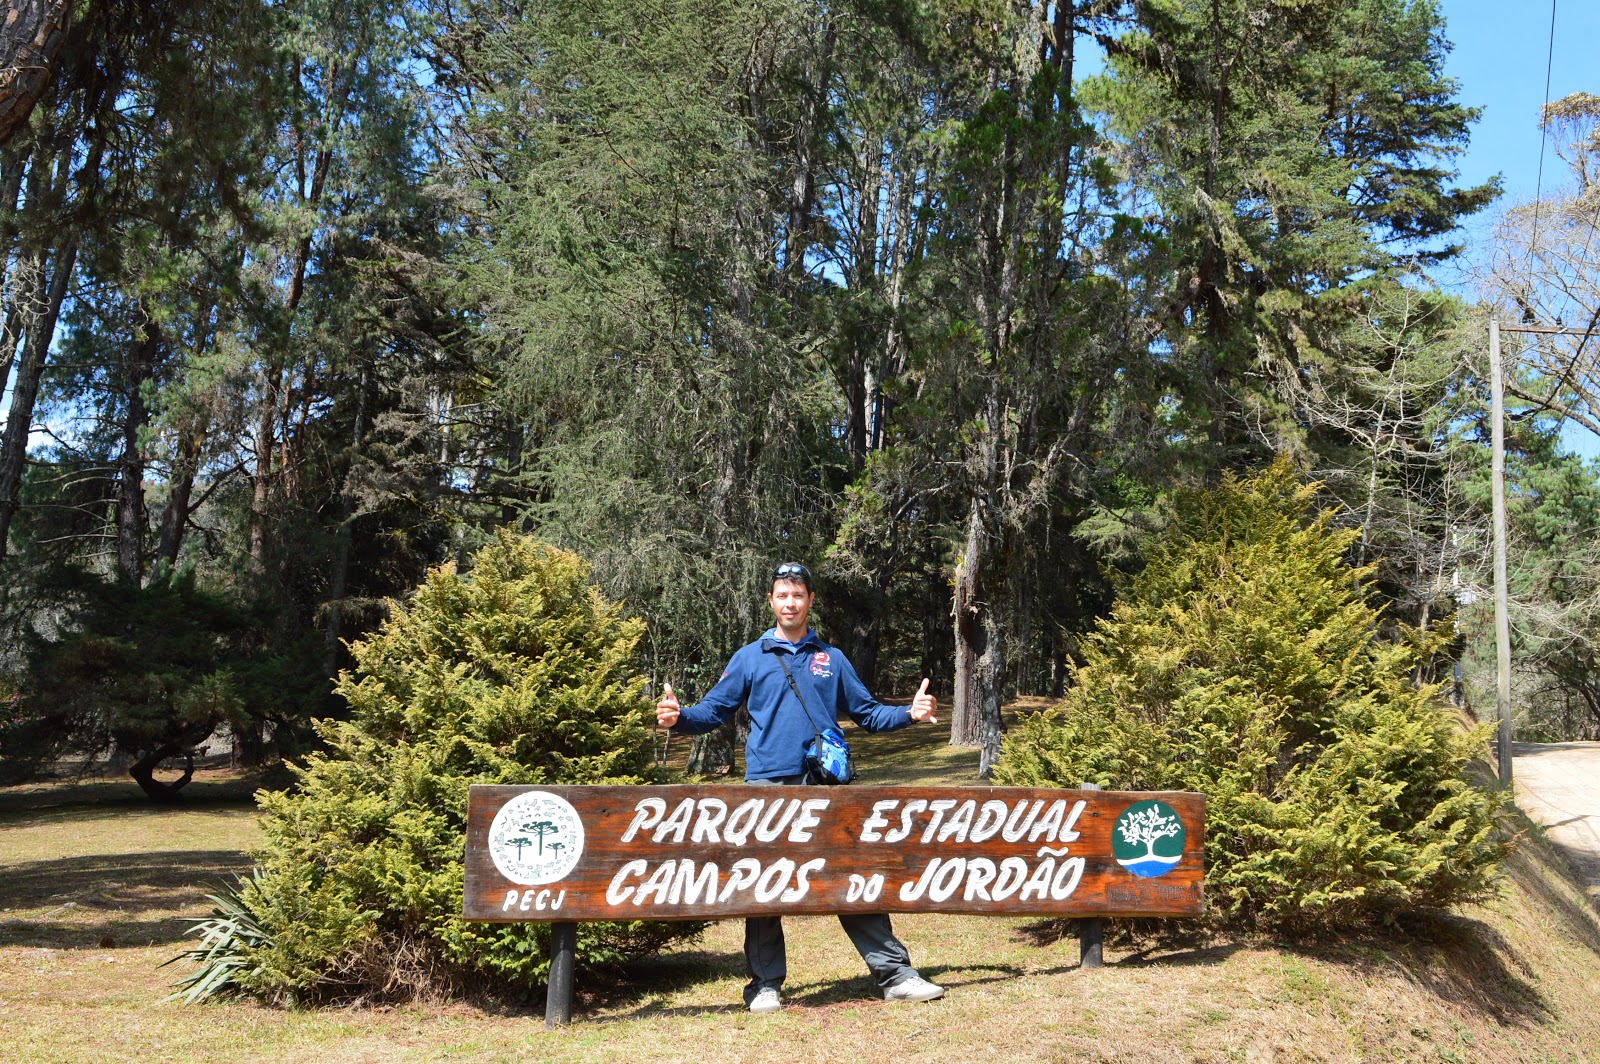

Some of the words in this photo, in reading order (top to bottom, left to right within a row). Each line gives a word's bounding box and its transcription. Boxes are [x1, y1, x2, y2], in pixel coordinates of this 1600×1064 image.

[620, 797, 831, 847] PARQUE
[859, 798, 1087, 844] ESTADUAL
[501, 889, 566, 912] PECJ
[605, 856, 826, 906] CAMPOS
[845, 873, 885, 903] DO
[899, 845, 1086, 903] JORDÃO
